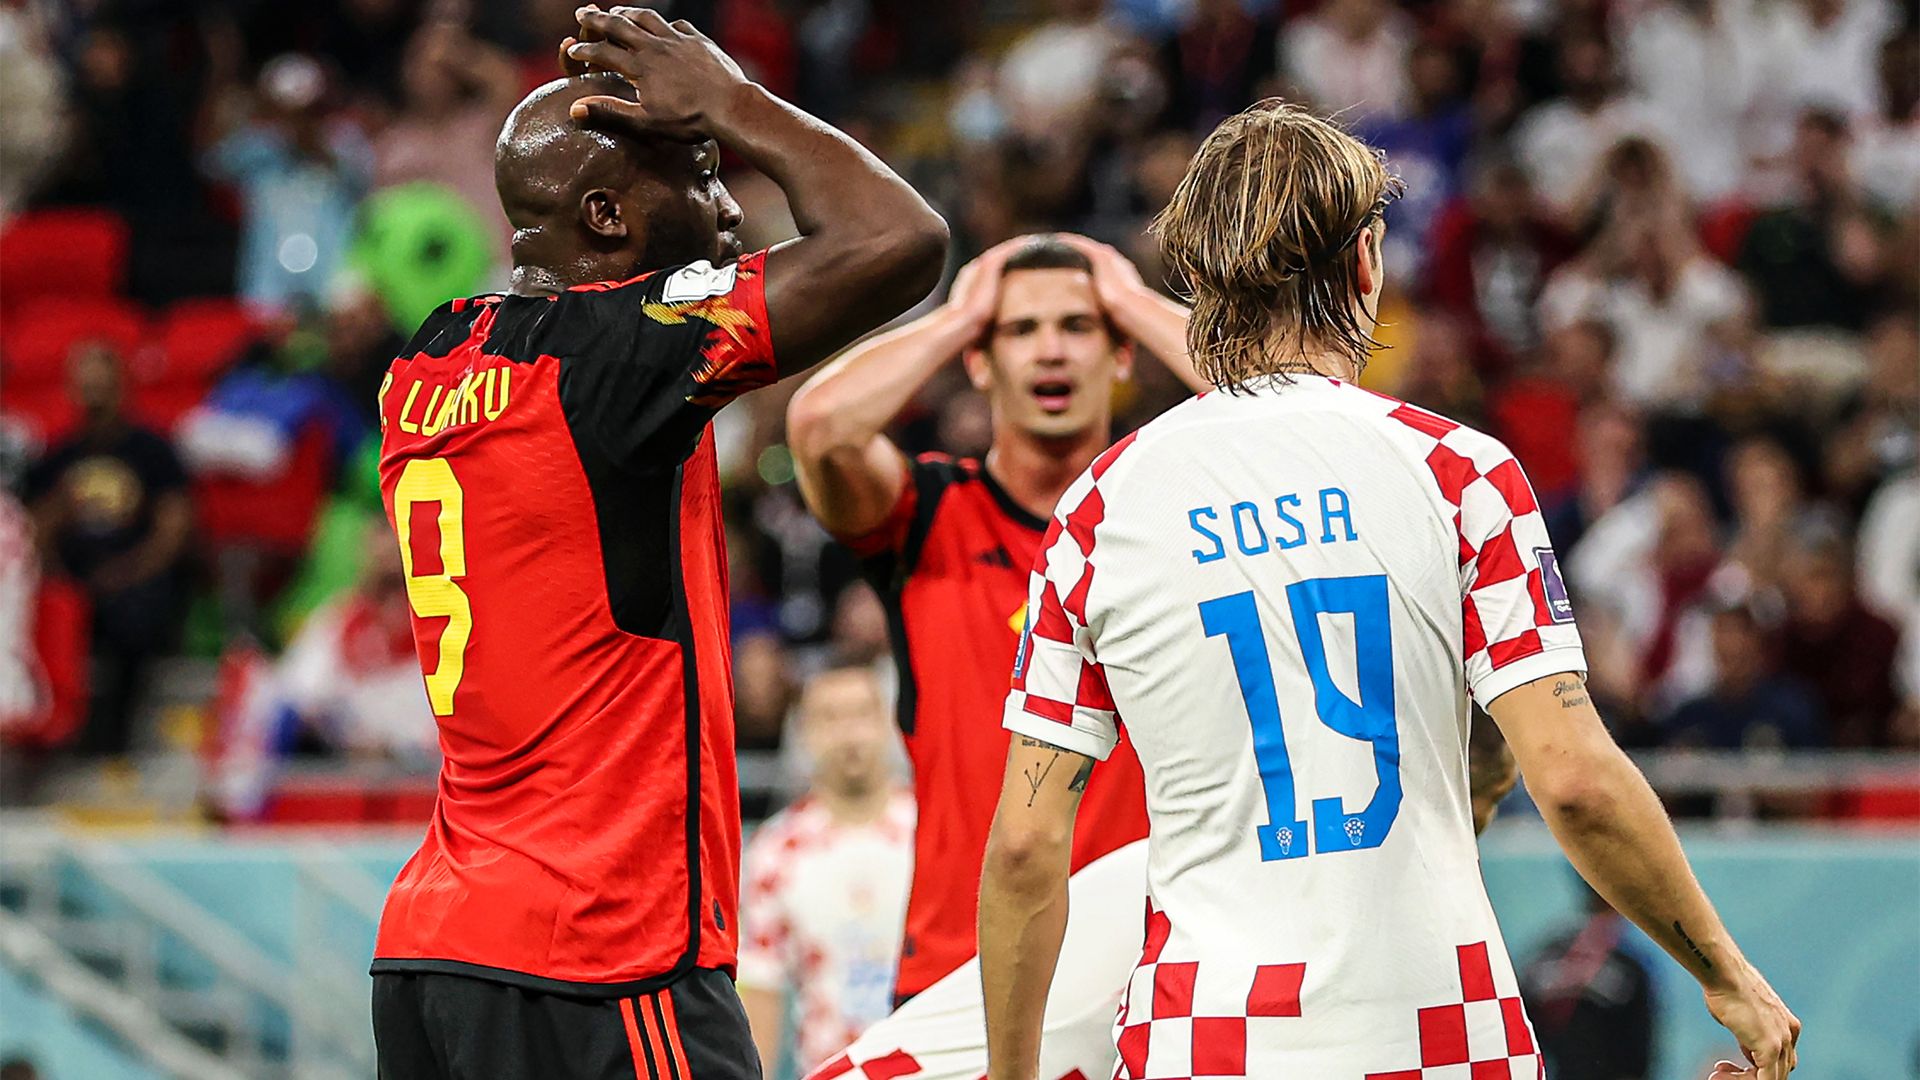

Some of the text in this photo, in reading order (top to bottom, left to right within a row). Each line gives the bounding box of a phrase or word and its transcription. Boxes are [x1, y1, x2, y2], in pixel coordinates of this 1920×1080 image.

[394, 457, 473, 717] 9
[1187, 486, 1358, 564] SOSA
[1197, 574, 1403, 862] 19
